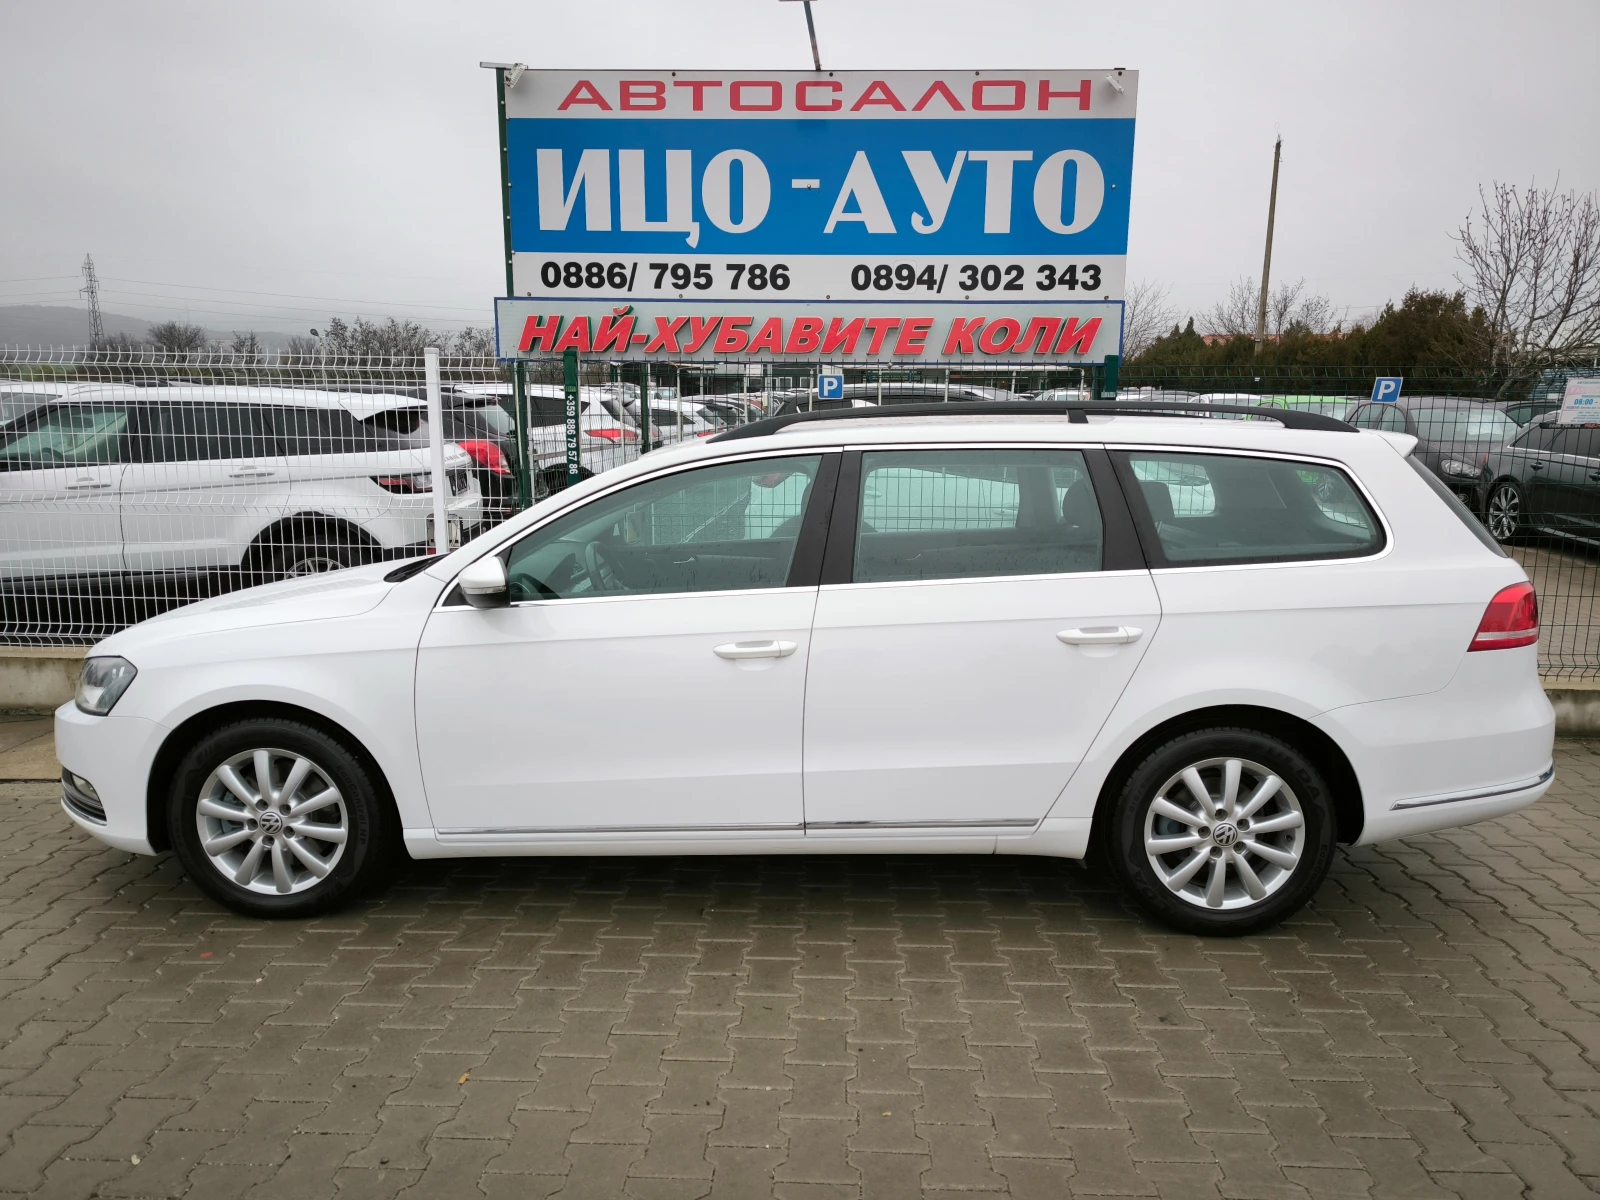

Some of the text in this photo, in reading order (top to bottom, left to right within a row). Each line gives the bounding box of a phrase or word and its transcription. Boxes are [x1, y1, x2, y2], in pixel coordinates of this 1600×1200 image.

[557, 79, 1092, 112] АВТОСАЛОН
[536, 148, 771, 249] ИЦО
[540, 261, 791, 292] 0886/ 795 786
[851, 263, 1102, 294] 0894/ 302 343
[517, 305, 1103, 356] НАЙ-ХУБАВИТЕ КОЛИ
[823, 377, 838, 397] P
[1376, 380, 1396, 400] P
[566, 394, 579, 475] +359 886 79 57 86
